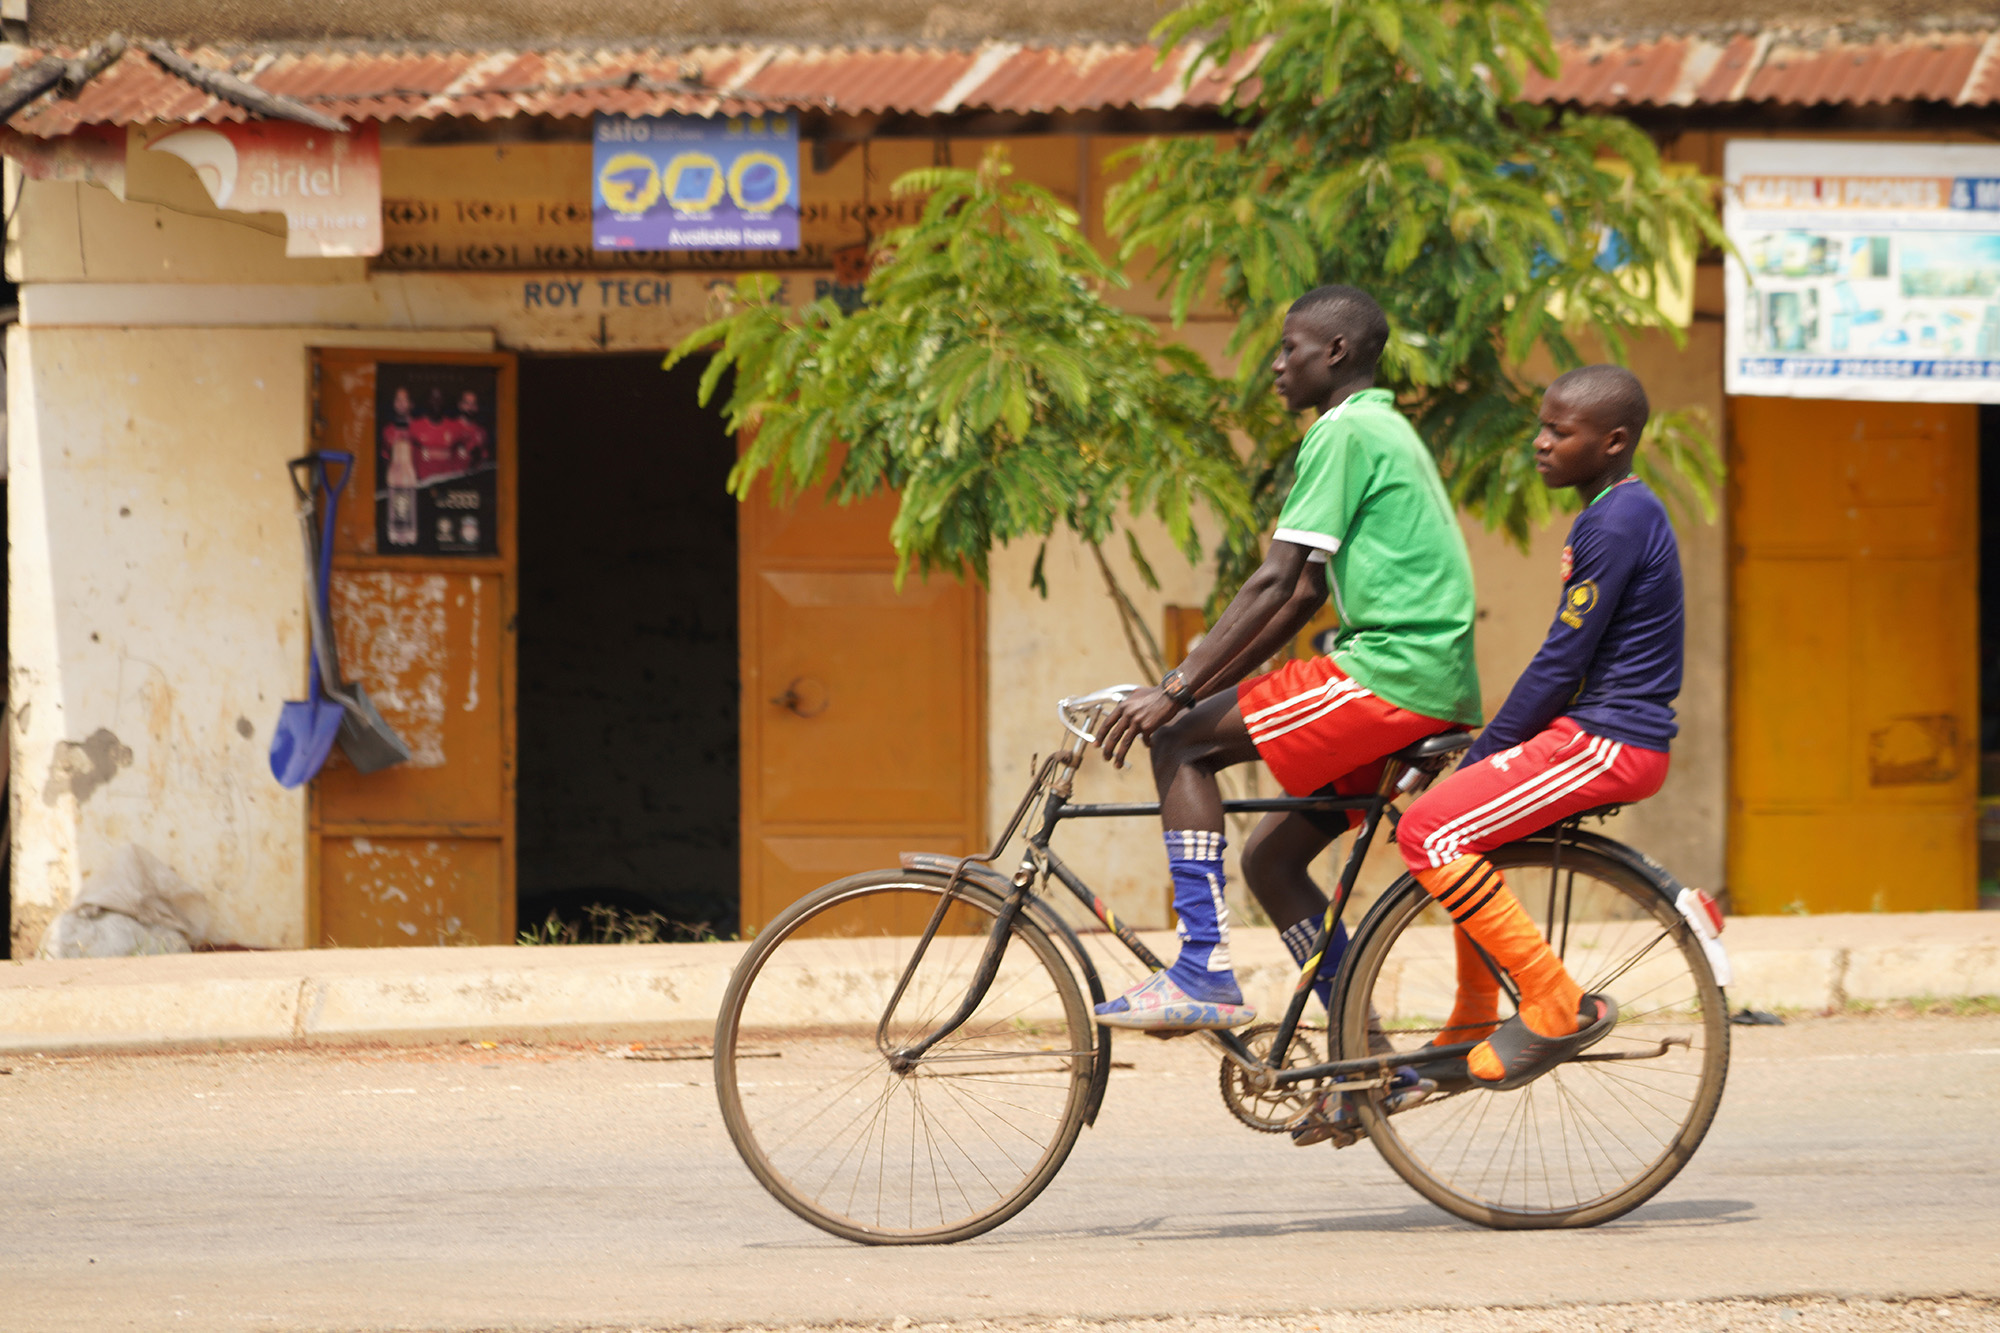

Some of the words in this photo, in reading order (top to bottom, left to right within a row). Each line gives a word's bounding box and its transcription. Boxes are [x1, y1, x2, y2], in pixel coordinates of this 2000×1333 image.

[250, 161, 343, 197] airtel
[1845, 180, 1940, 208] PHONES
[1953, 181, 1972, 208] &
[322, 212, 368, 230] here
[668, 227, 742, 246] Available
[743, 227, 782, 246] here
[524, 279, 584, 308] ROY
[597, 278, 673, 307] TECH
